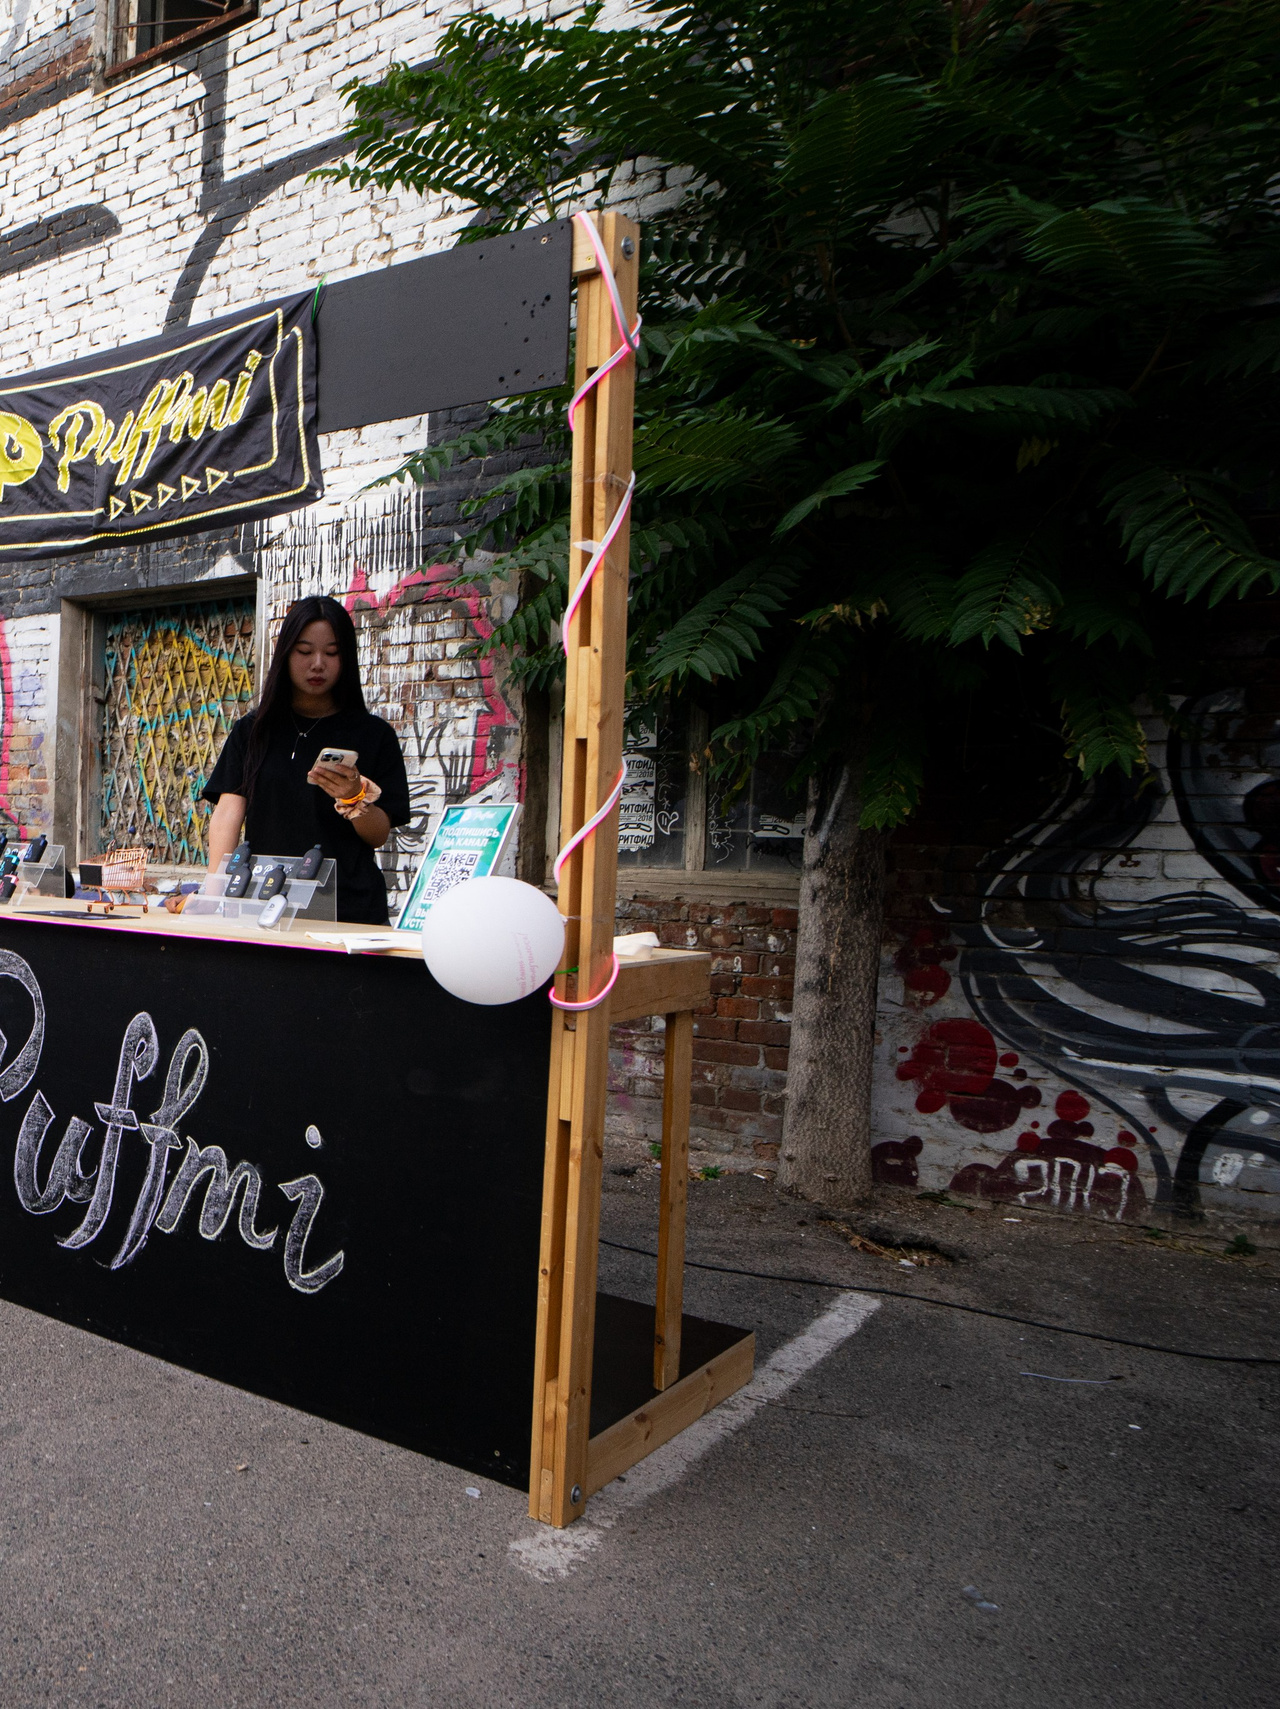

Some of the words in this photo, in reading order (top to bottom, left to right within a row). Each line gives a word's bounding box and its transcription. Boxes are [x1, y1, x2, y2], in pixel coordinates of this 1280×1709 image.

[48, 349, 263, 494] Puffmi
[638, 770, 654, 778] 2018
[619, 803, 655, 814] РИТФИД
[441, 827, 500, 839] ПОДПИШИСЬ
[443, 837, 456, 847] НА
[458, 838, 490, 848] КАНАЛ
[618, 835, 655, 845] РИТФИД
